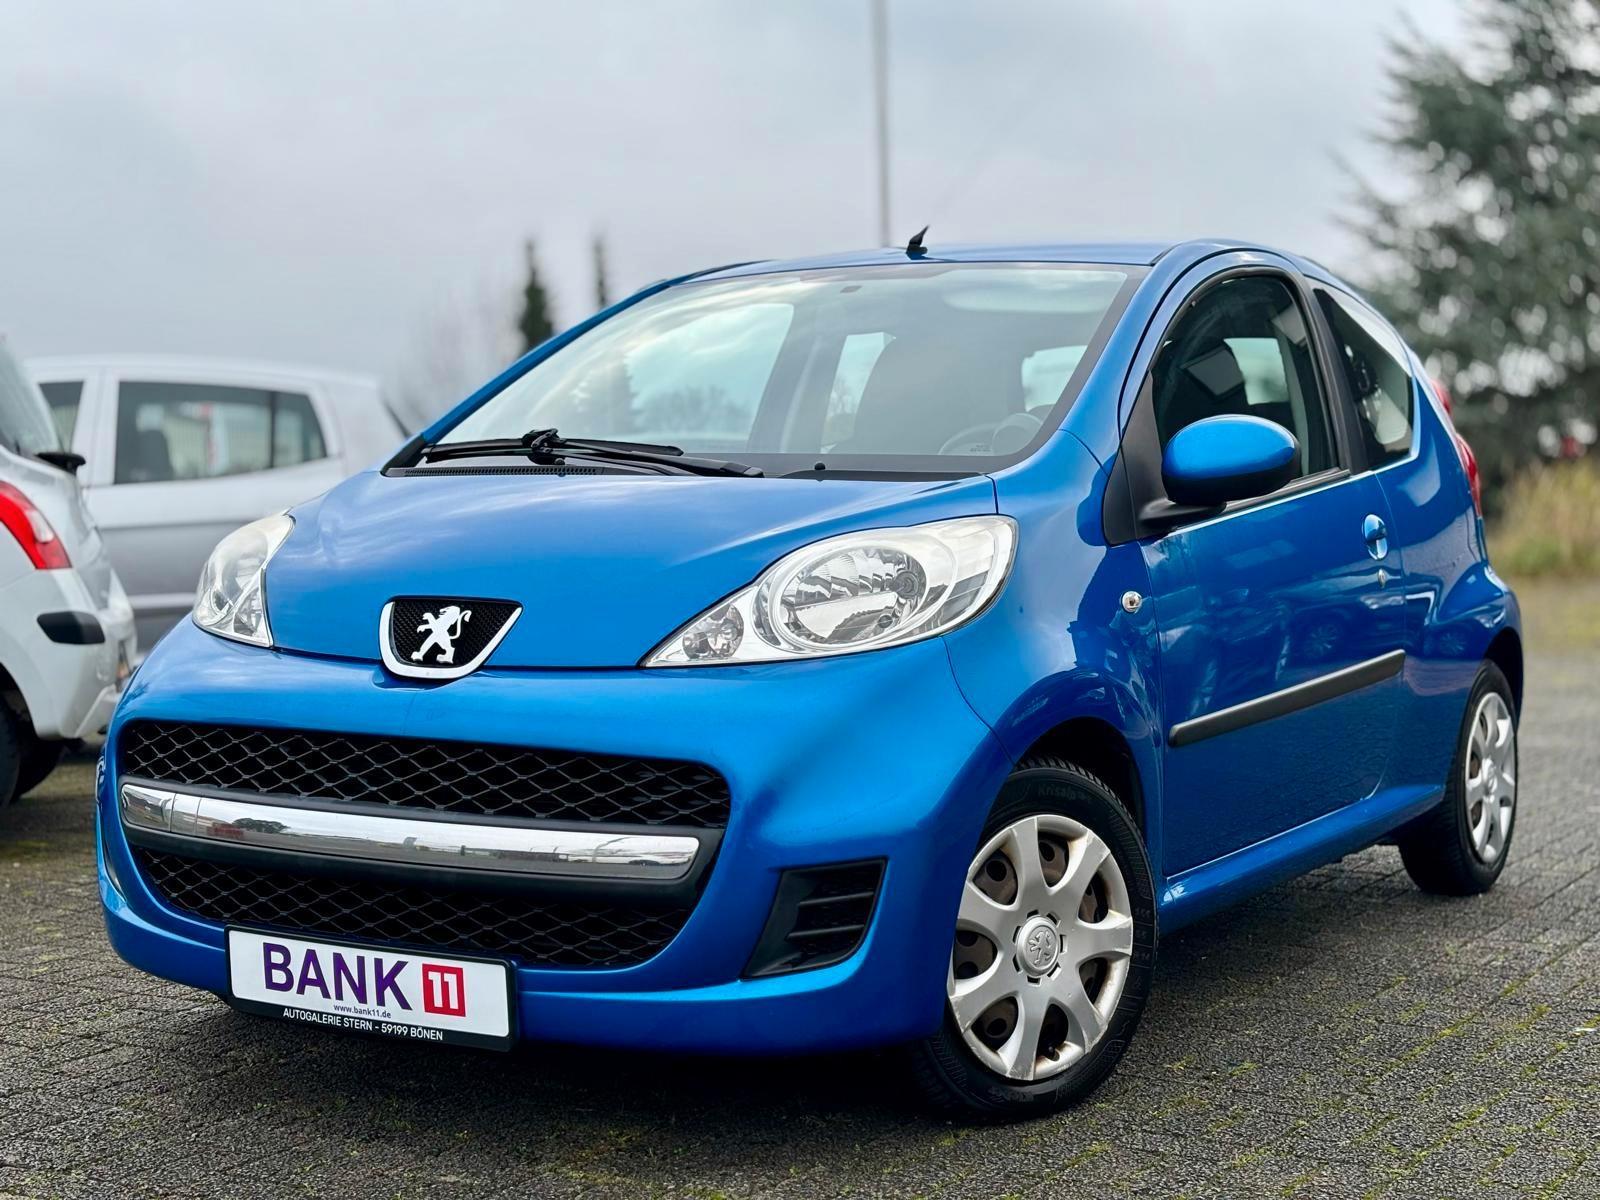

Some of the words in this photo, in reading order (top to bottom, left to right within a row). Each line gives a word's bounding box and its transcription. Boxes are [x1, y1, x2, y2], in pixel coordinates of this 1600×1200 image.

[263, 942, 413, 1011] BANK
[428, 971, 459, 1010] 11
[283, 1007, 342, 1026] AUTOGALERIE
[343, 1017, 373, 1031] STERN
[381, 1023, 409, 1036] 59199
[410, 1026, 443, 1041] BÖNEN
[333, 1004, 392, 1019] www.bank11.de
